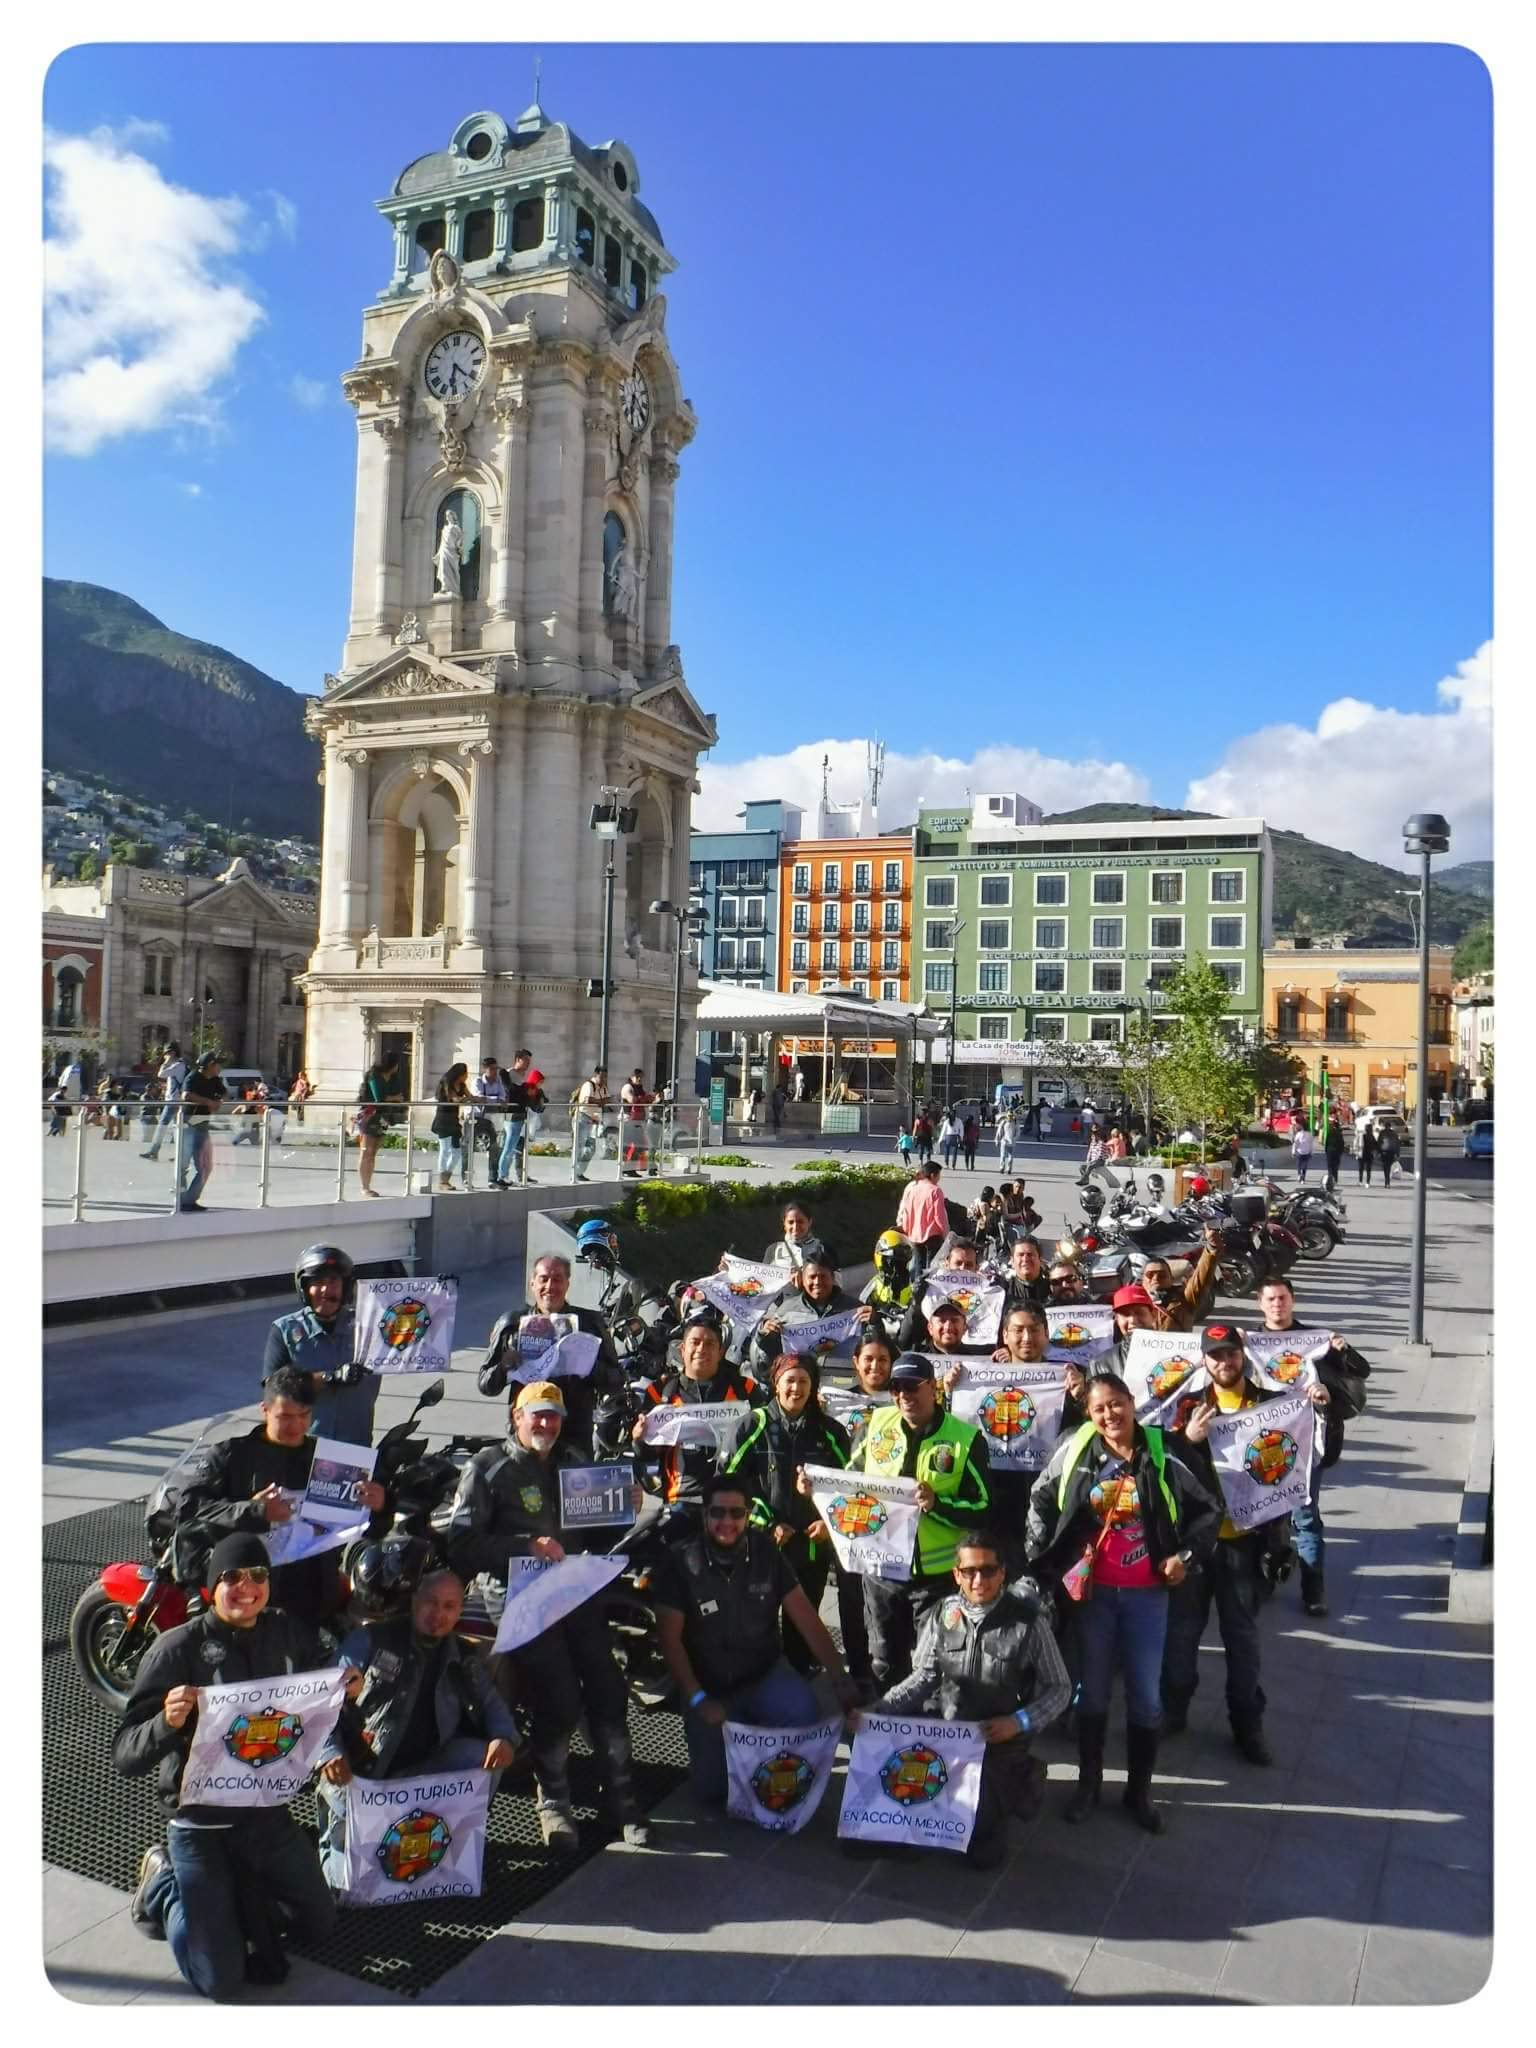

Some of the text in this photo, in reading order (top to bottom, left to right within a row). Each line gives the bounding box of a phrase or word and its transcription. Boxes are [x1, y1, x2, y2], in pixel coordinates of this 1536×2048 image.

[928, 816, 967, 825] EDIFICIO
[944, 994, 1022, 1006] SECRETARIA
[1024, 994, 1042, 1006] DE
[1047, 995, 1064, 1006] LA
[368, 1282, 404, 1294] MOTO
[788, 1326, 817, 1337] MOTO
[1141, 1338, 1174, 1351] MOTO
[1251, 1336, 1282, 1346] MOTO
[967, 1369, 1057, 1383] MOTO TURISTA
[1216, 1398, 1304, 1436] MOTO TURISTA
[564, 1495, 603, 1510] RODADOR
[604, 1487, 624, 1513] 11
[1233, 1504, 1248, 1518] EN
[211, 1679, 330, 1706] MOTO TURISTA
[868, 1719, 972, 1740] MOTO TURISTA
[733, 1731, 777, 1748] MOTO
[203, 1774, 264, 1790] ACCIÓN
[360, 1779, 474, 1807] MOTO TURISTA
[843, 1810, 859, 1822] EN
[862, 1808, 912, 1826] ACCIÓN
[420, 1881, 474, 1898] MÉXICO
